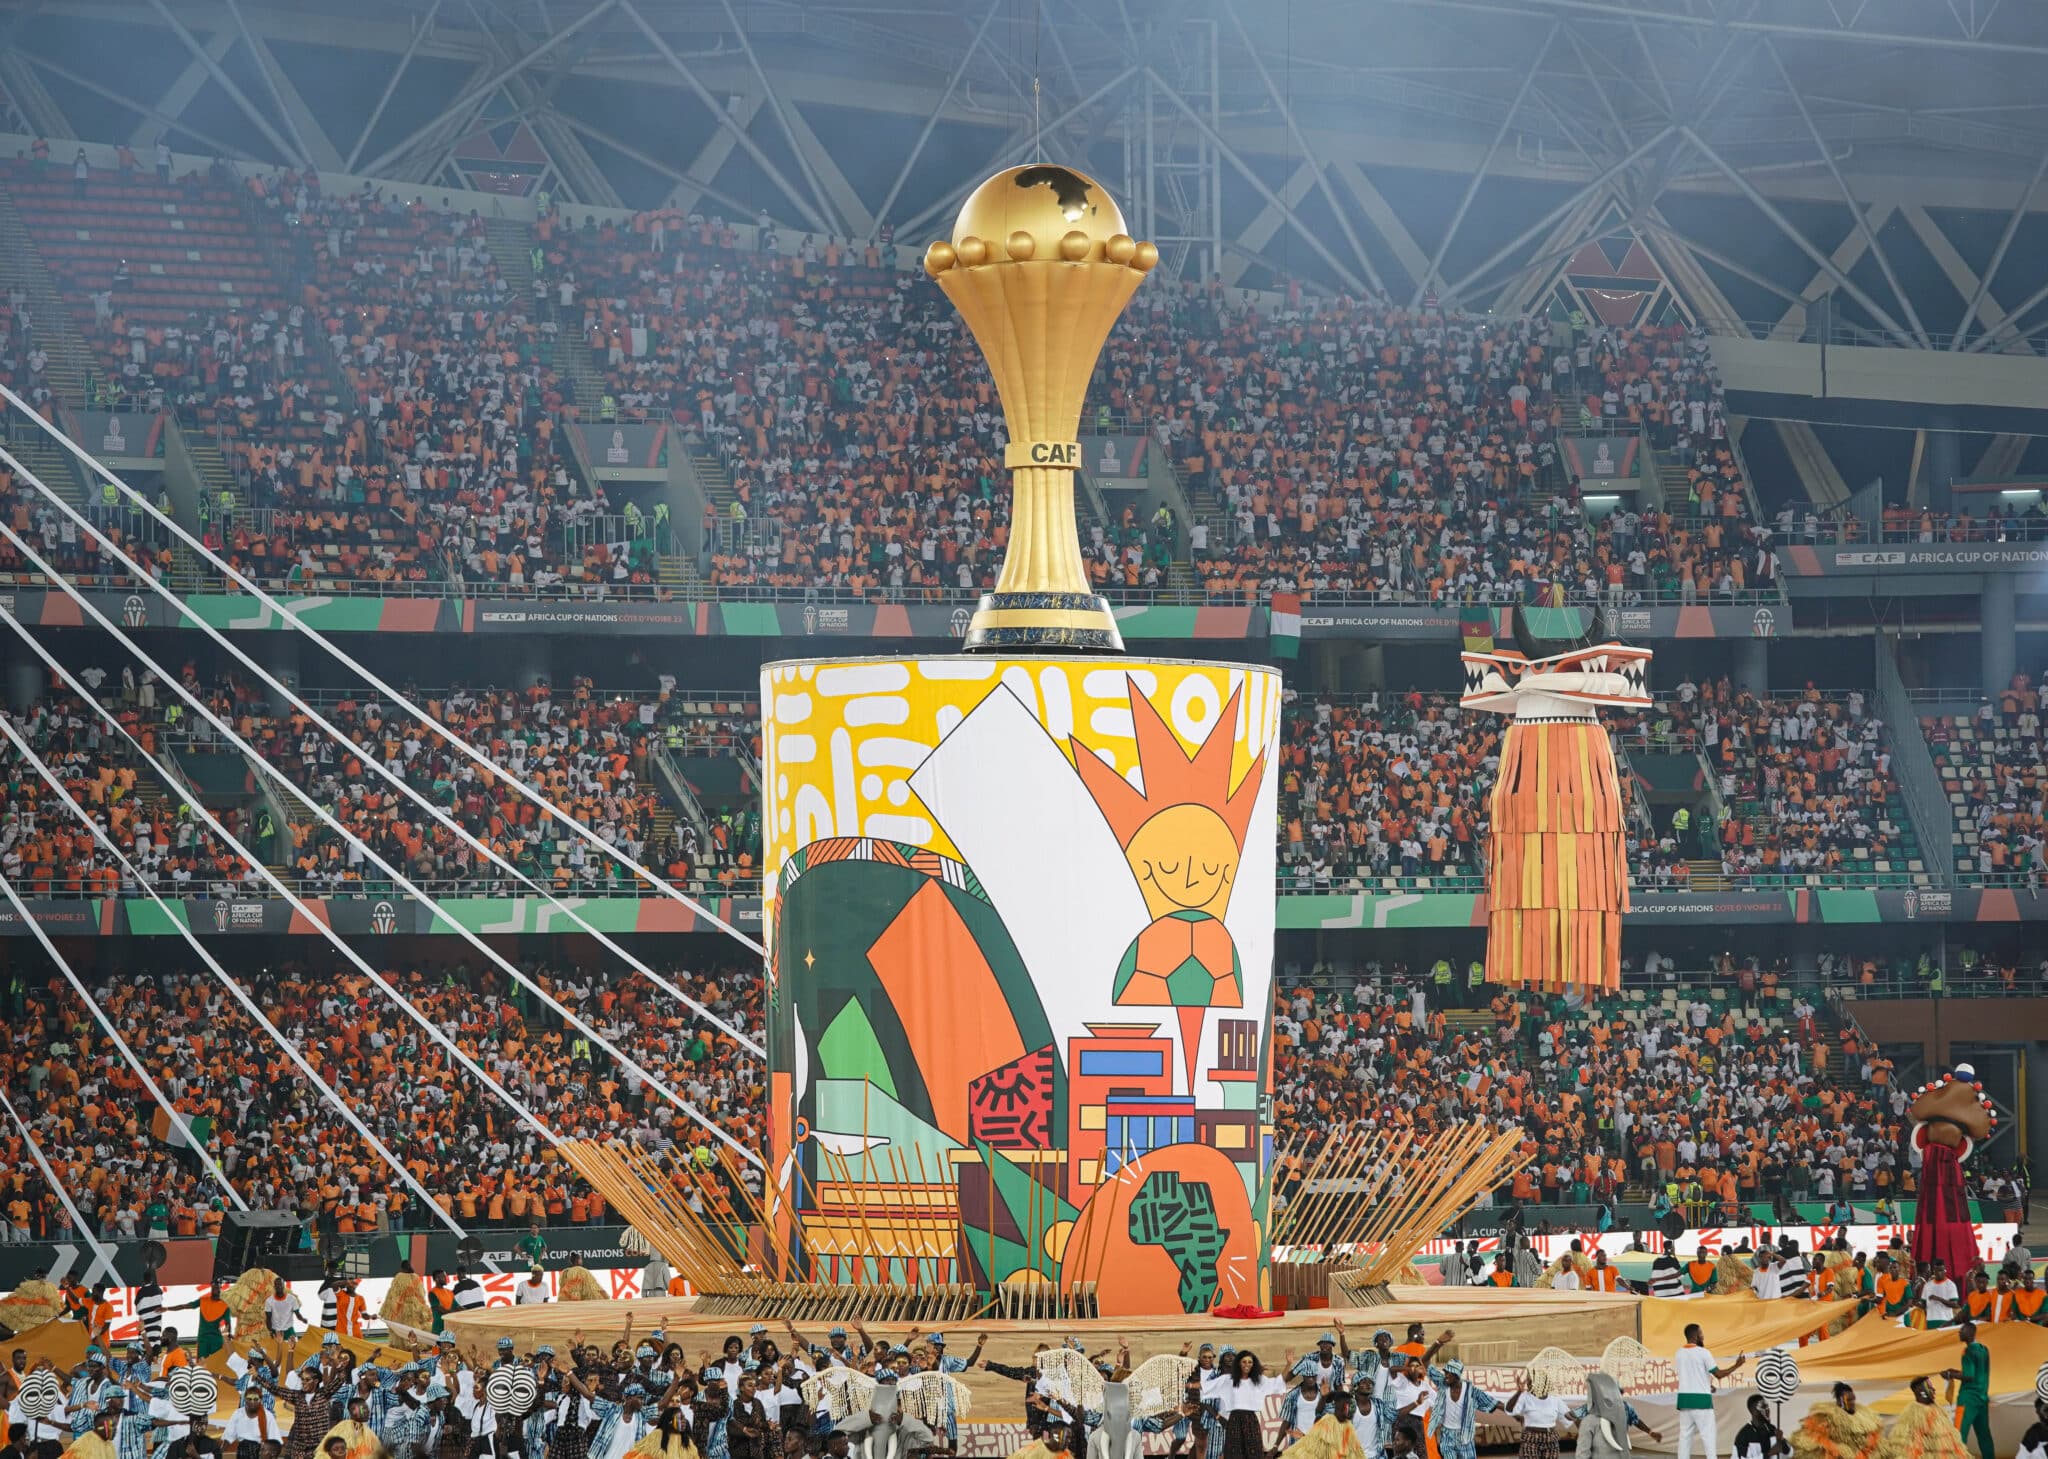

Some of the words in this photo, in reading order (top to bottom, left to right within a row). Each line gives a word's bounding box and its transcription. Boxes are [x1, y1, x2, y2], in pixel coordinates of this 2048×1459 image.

[1031, 443, 1076, 463] CAF
[1862, 553, 1899, 563] CAF
[1909, 552, 1954, 563] AFRICA
[1956, 551, 1980, 562] CUP
[1982, 551, 2000, 562] OF
[2001, 550, 2048, 561] NATION
[498, 613, 521, 621] CAF
[528, 612, 556, 622] AFRICA
[556, 613, 573, 622] CUP
[573, 613, 584, 622] OF
[585, 613, 618, 622] NATIONS
[1391, 618, 1423, 626] NATIONS
[1650, 904, 1665, 913] CUP
[1666, 904, 1677, 913] OF
[1678, 904, 1714, 913] NATIONS
[1480, 1228, 1498, 1236] CUP
[549, 1250, 568, 1259] CUP
[583, 1248, 624, 1258] NATIONS
